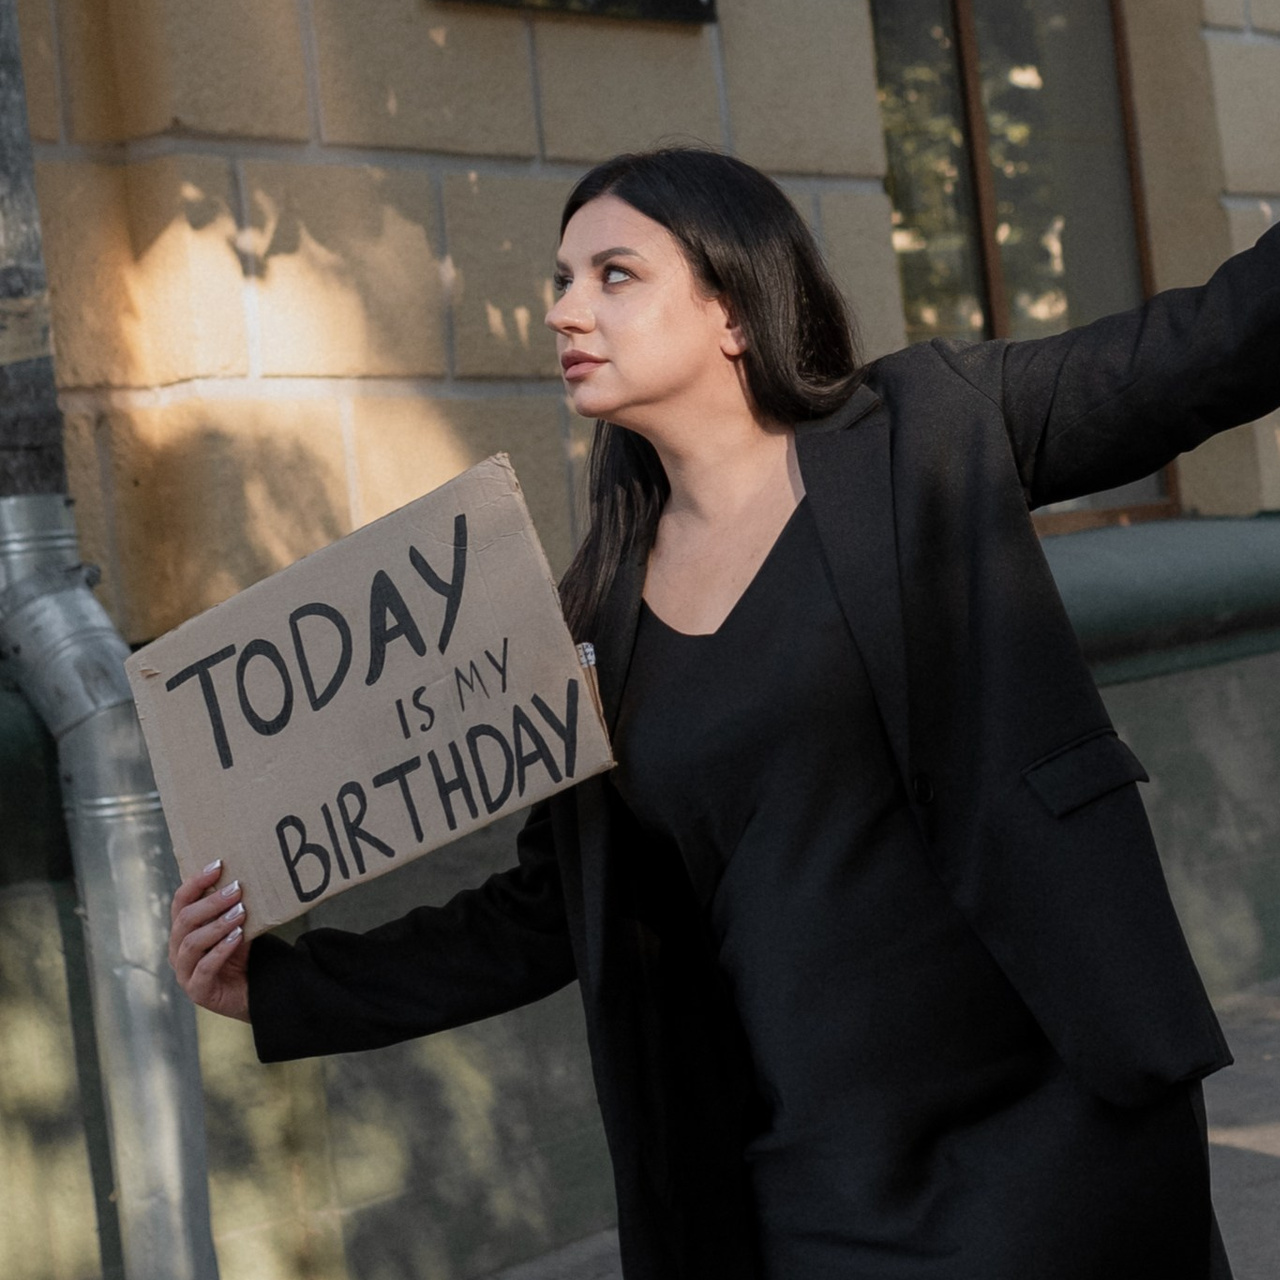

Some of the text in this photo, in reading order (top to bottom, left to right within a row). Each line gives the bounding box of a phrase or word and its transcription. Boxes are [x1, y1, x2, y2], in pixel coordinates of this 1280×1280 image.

[165, 513, 467, 769] TODAY
[396, 685, 435, 739] IS
[454, 637, 508, 711] MY
[276, 678, 579, 903] BIRTHDAY
